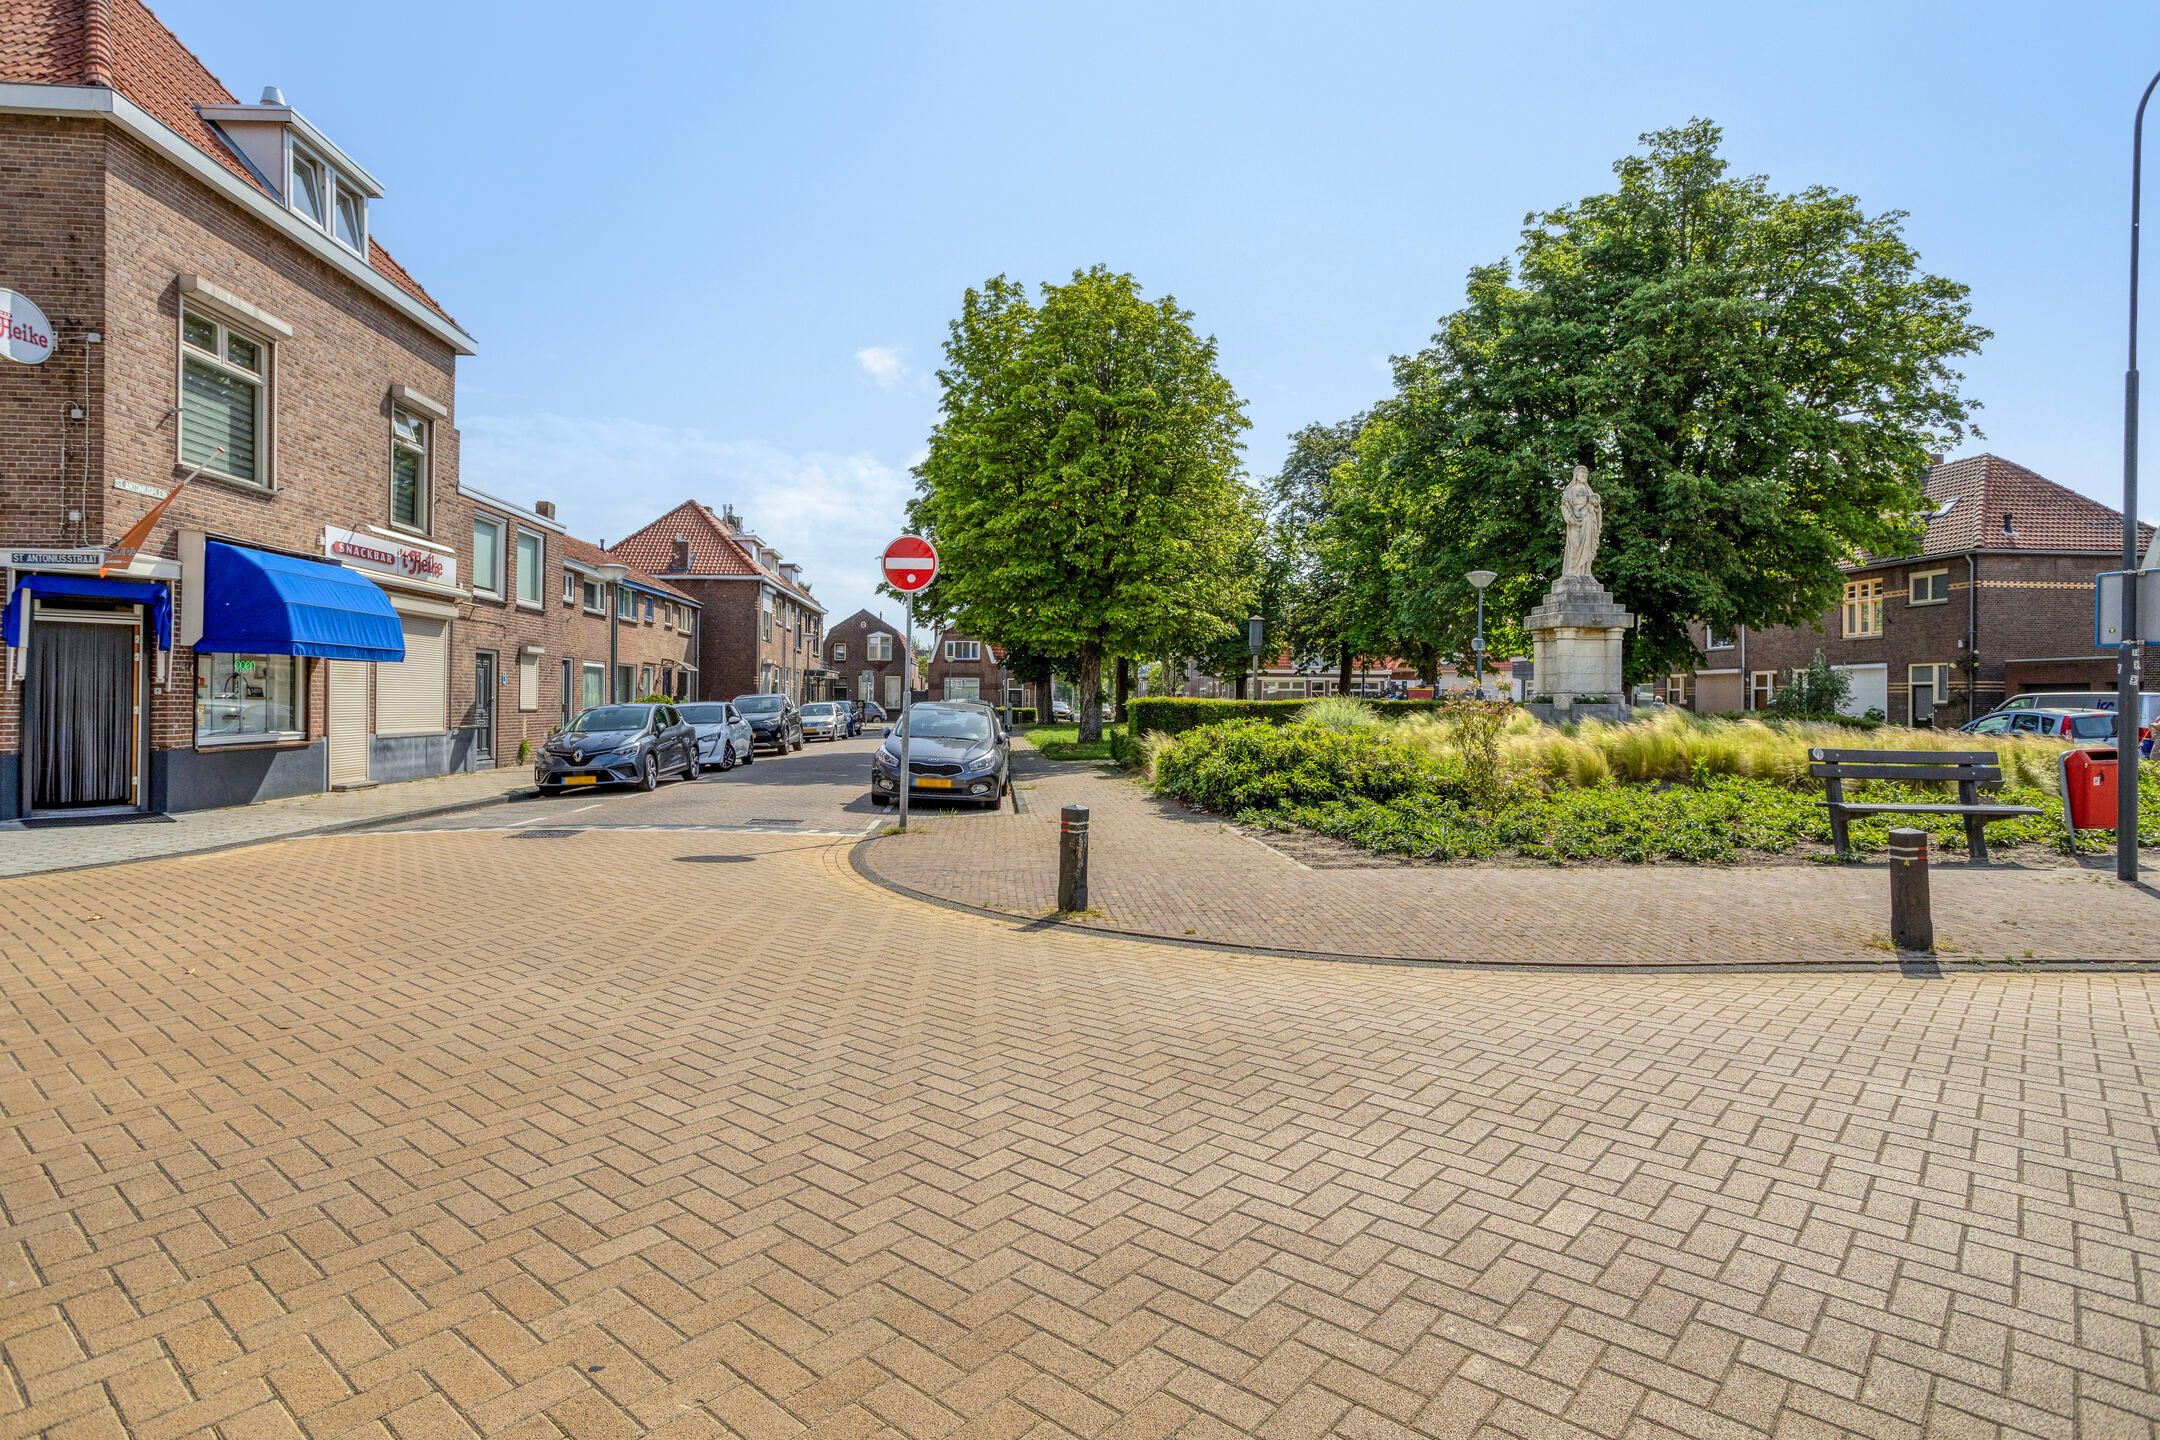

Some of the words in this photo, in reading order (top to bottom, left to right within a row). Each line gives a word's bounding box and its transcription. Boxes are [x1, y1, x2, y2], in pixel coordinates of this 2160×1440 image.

[27, 554, 98, 564] ANTONIUSSTRAAT
[339, 543, 393, 564] SNACKBAR
[408, 550, 443, 578] Heike
[234, 660, 256, 673] open
